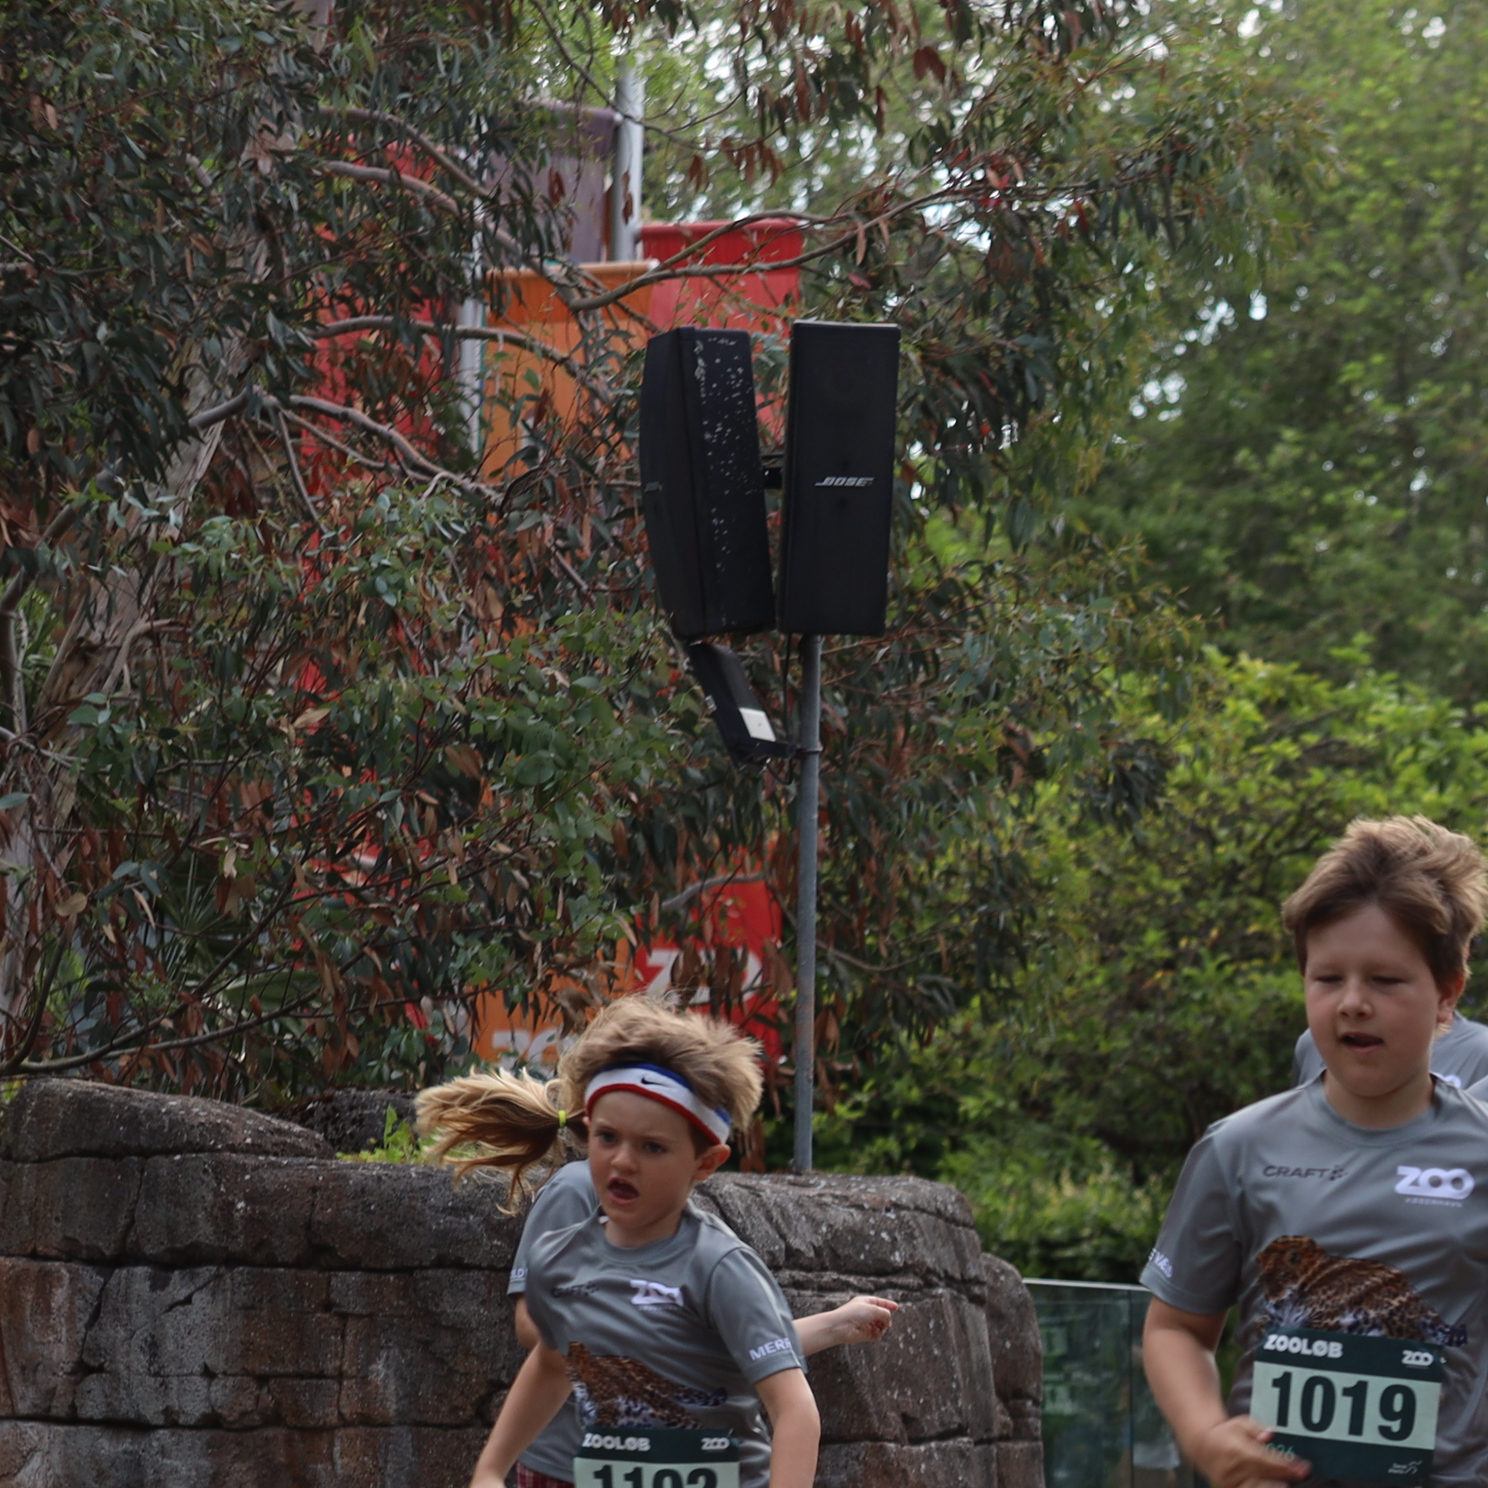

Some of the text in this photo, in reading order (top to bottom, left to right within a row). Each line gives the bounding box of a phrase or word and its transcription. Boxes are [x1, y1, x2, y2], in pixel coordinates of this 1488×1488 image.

[815, 476, 874, 487] BOSE
[1263, 1165, 1329, 1180] CRAFT
[1395, 1165, 1475, 1200] ZOO
[1264, 1334, 1343, 1358] ZOOLØB
[1402, 1350, 1434, 1366] ZOO
[1271, 1371, 1417, 1441] 1019
[582, 1433, 650, 1451] ZOOLØB
